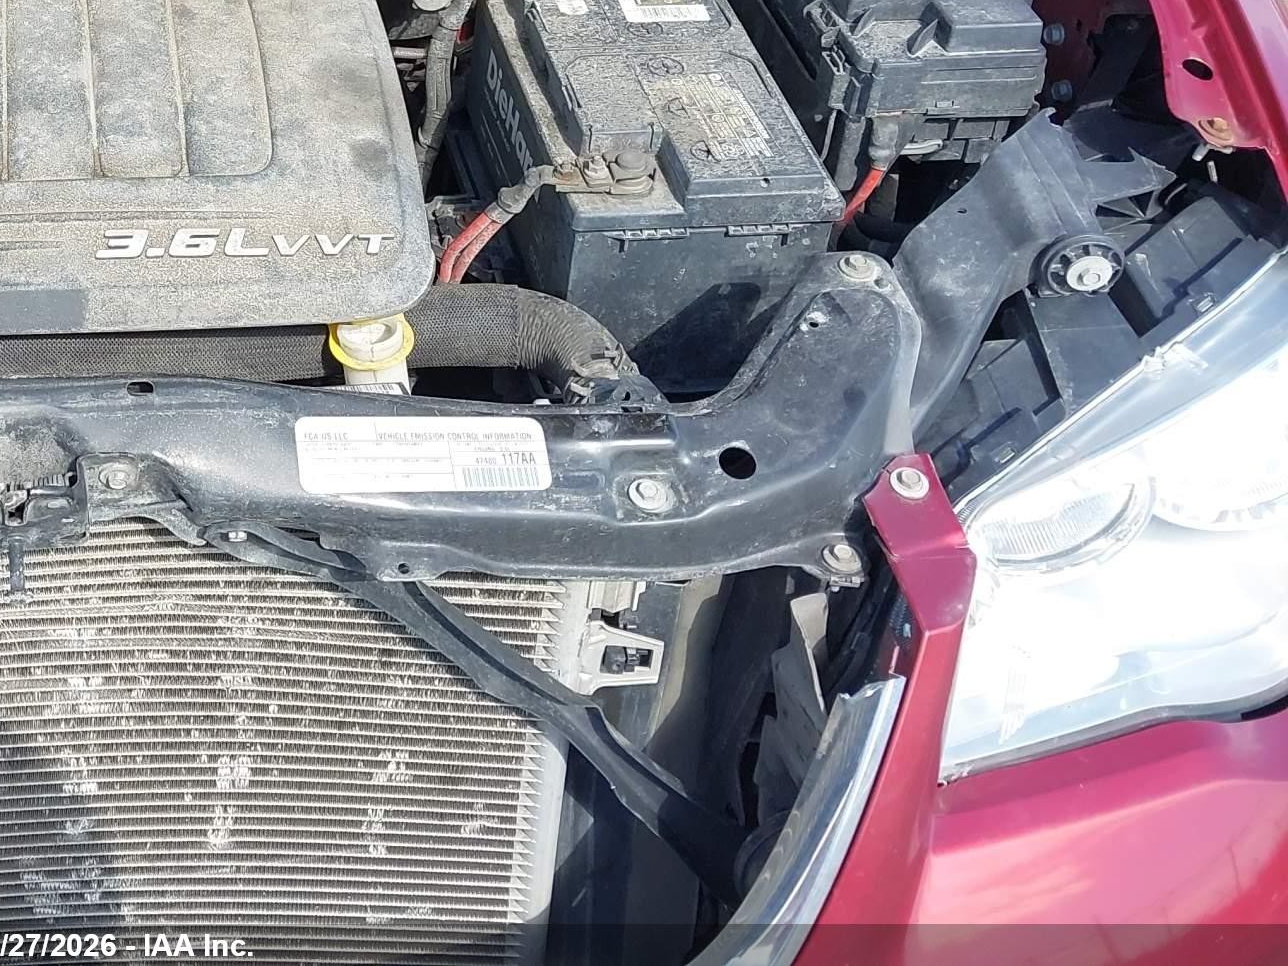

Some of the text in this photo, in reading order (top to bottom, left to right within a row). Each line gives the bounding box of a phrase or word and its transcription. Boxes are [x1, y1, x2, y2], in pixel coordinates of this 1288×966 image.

[486, 51, 533, 172] DieHar
[95, 227, 396, 259] 3.6L VVT
[378, 431, 532, 442] VEHICLE EMISSION CONTROL INFORMATION
[501, 451, 537, 466] 117AA
